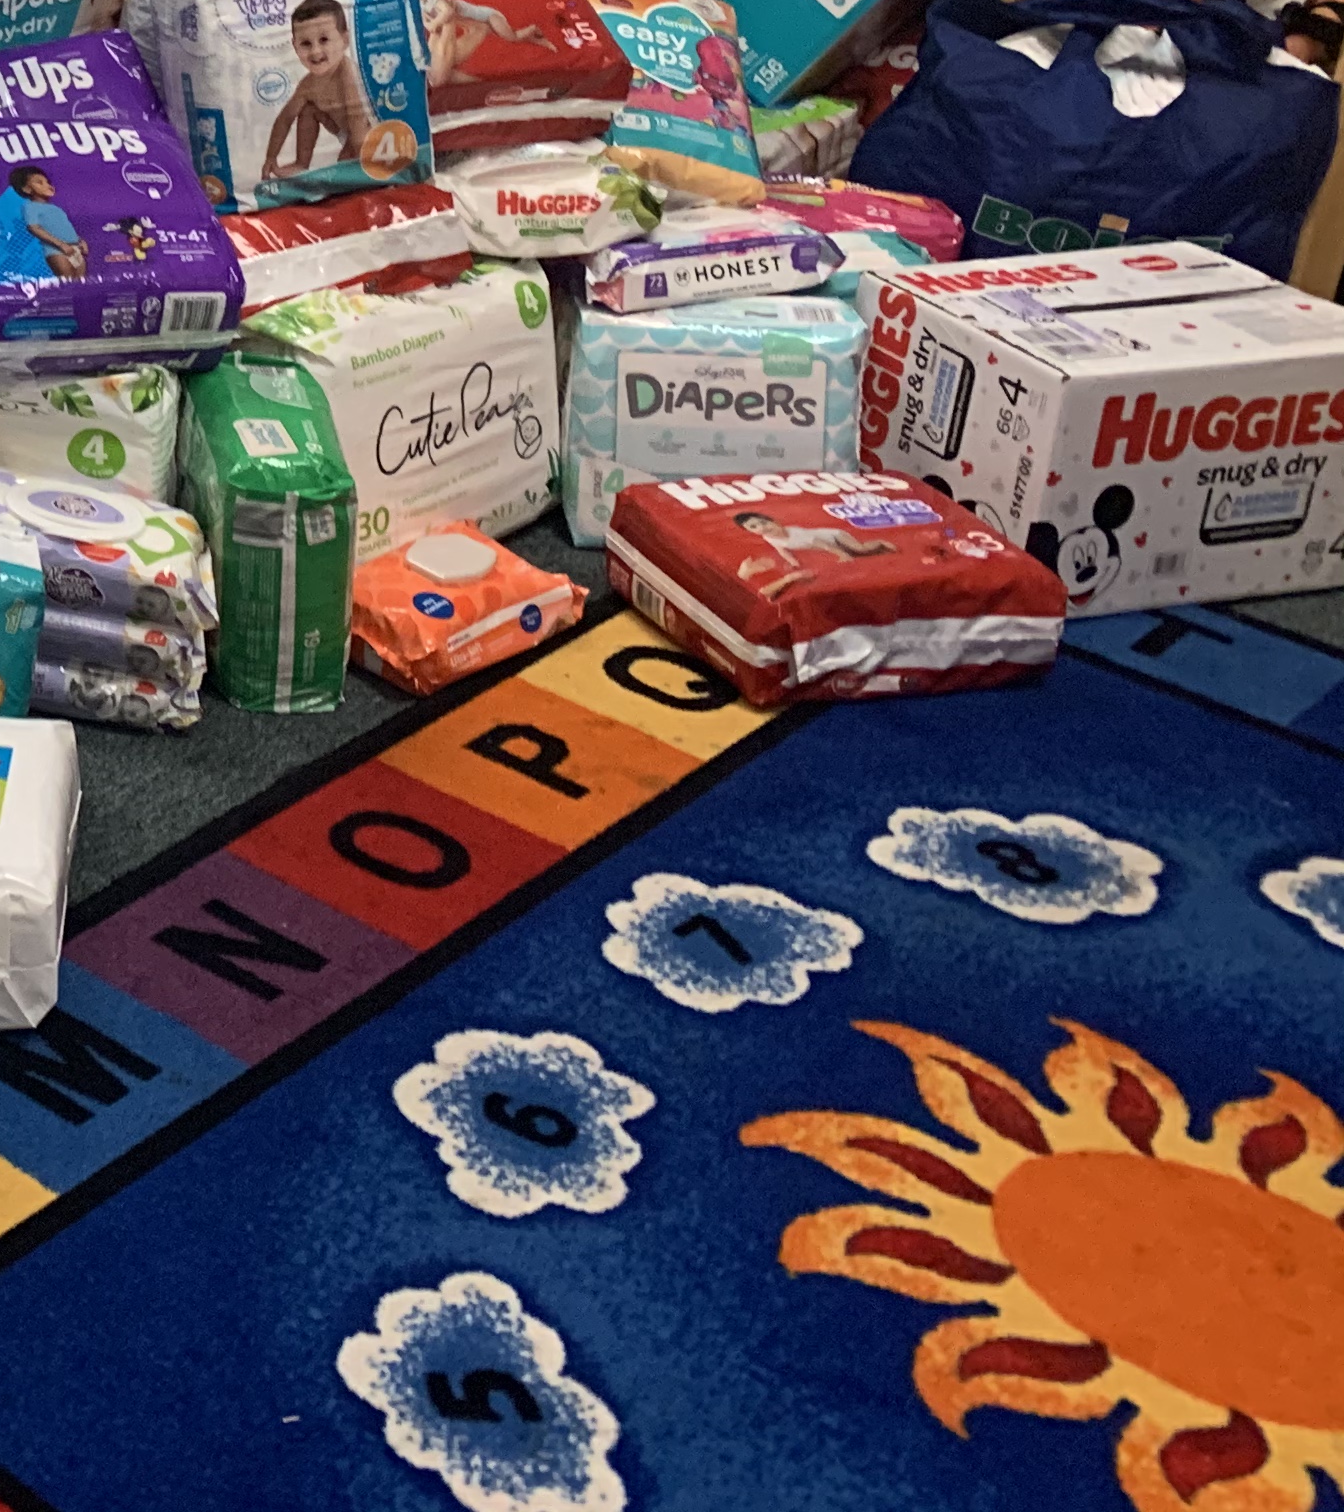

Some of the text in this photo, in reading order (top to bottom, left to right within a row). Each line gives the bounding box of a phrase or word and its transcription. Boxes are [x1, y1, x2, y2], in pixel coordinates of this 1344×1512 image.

[244, 10, 288, 29] toes
[577, 20, 598, 42] 5
[617, 23, 687, 52] easy
[637, 42, 694, 70] ups
[752, 57, 784, 86] 156
[375, 129, 399, 165] 4
[496, 190, 602, 216] HUGGIES
[155, 227, 209, 244] 3T-4T
[649, 276, 663, 288] 72
[694, 256, 782, 283] HONEST
[522, 283, 540, 311] 4
[350, 327, 445, 371] Bamboo Diapers
[897, 326, 938, 453] snug dry
[998, 373, 1029, 406] 4
[996, 408, 1012, 435] 66
[80, 434, 108, 468] 4
[1197, 453, 1328, 486] snug & dry
[656, 470, 911, 513] HUGGIES
[359, 506, 390, 540] 30
[1130, 612, 1236, 661] T
[603, 645, 741, 718] Q
[462, 720, 592, 802] P
[326, 811, 473, 894] O
[971, 837, 1063, 888] 8
[153, 897, 332, 1002] N
[667, 913, 762, 970] 7
[2, 1020, 162, 1130] M
[478, 1089, 584, 1151] 6
[424, 1365, 548, 1430] 5
